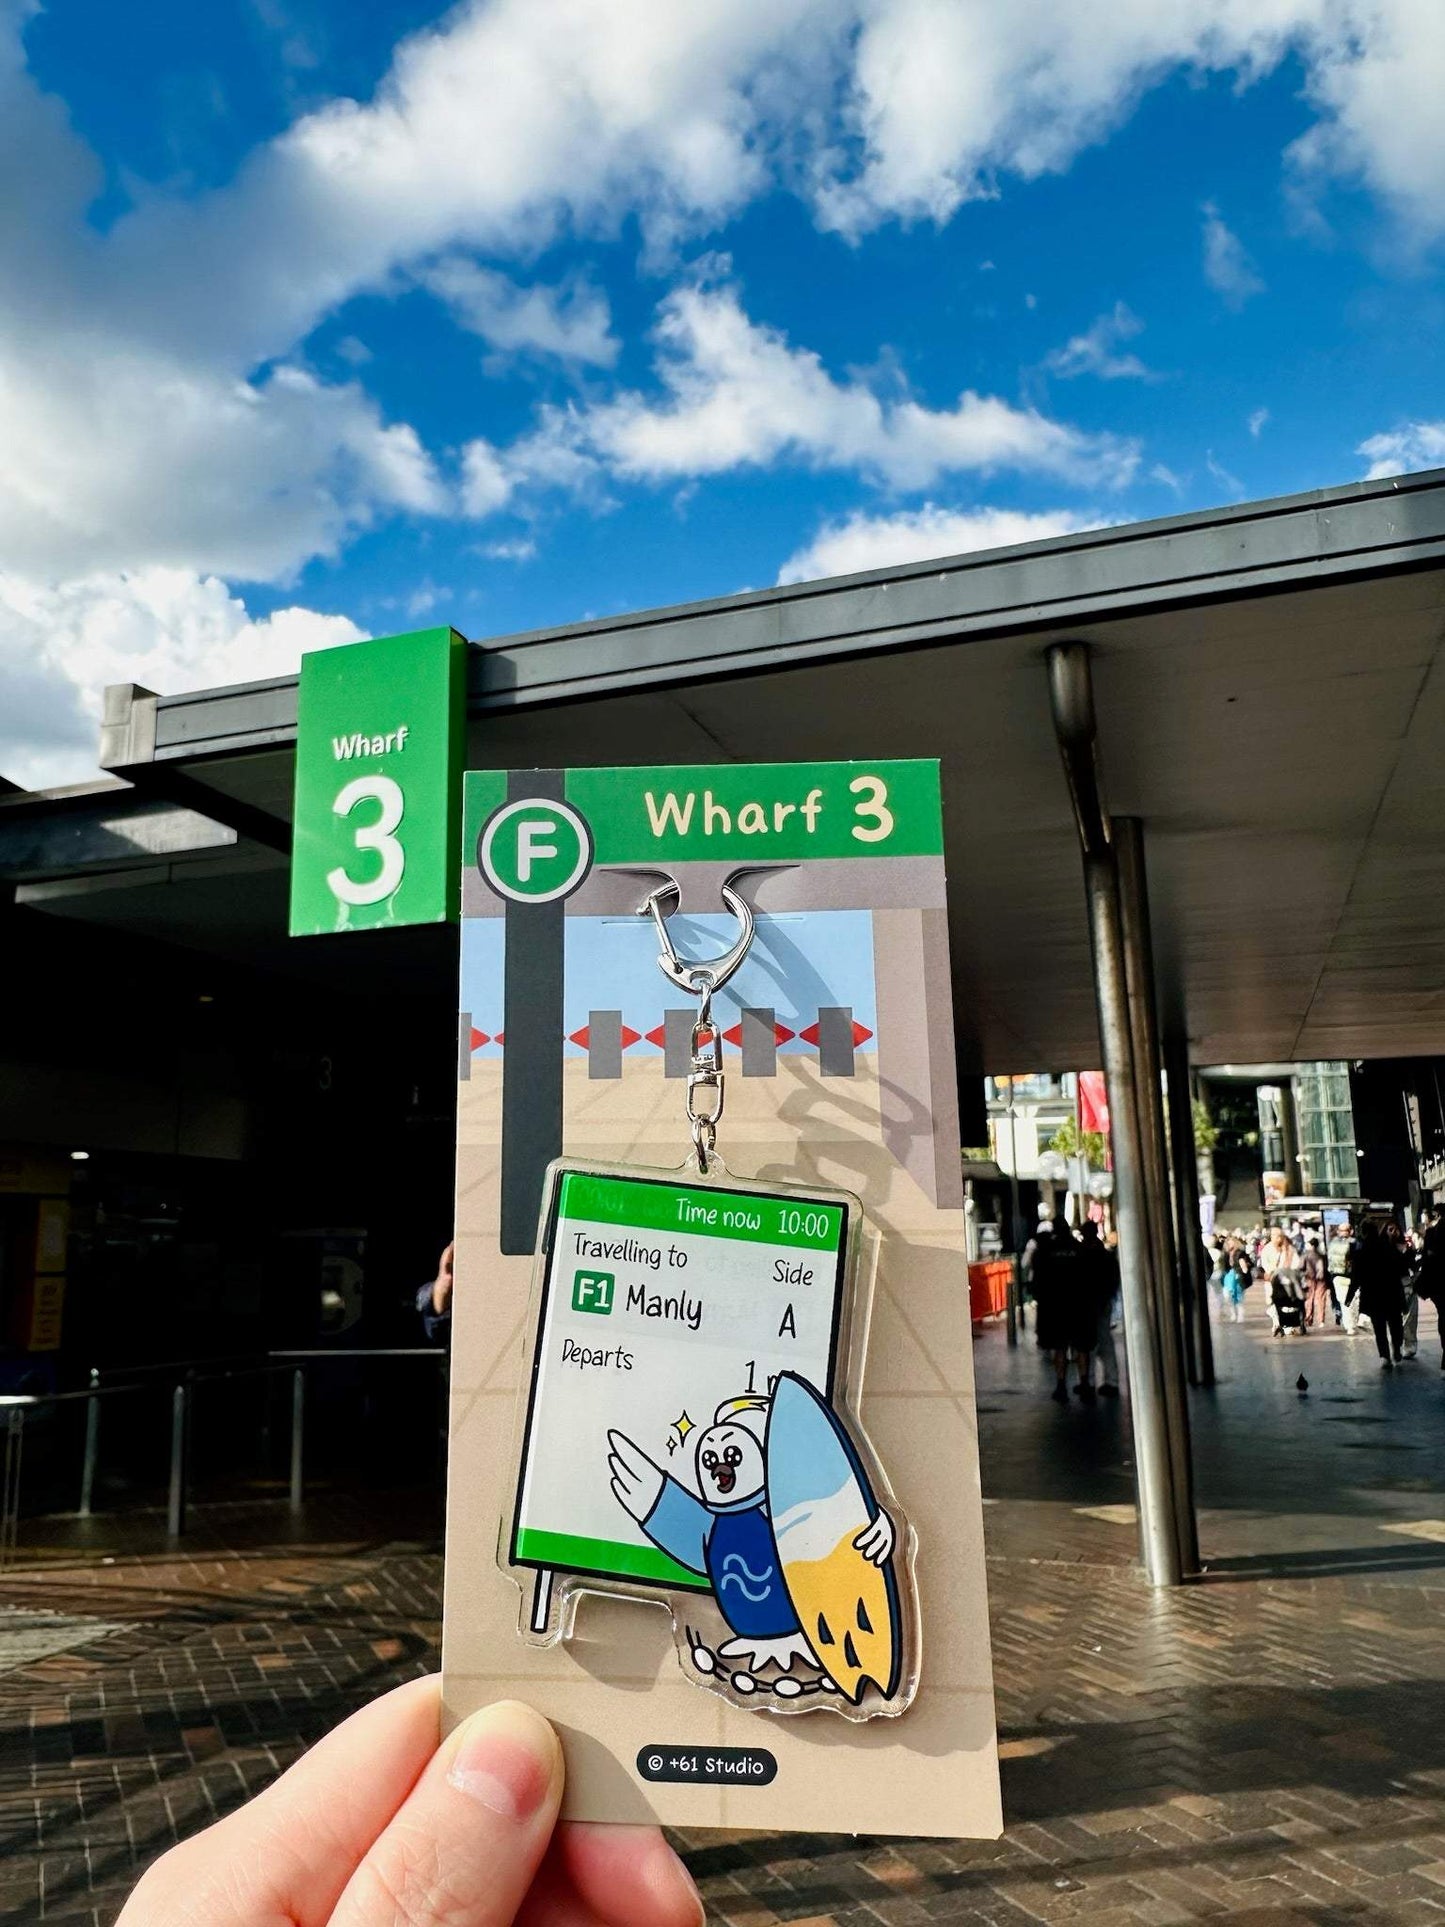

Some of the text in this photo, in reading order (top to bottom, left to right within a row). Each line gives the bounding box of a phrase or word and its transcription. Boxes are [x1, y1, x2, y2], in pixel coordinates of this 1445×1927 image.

[332, 726, 408, 760] Wharf
[644, 775, 894, 842] Wharf 3
[327, 775, 405, 905] 3
[517, 821, 558, 882] F
[676, 1198, 829, 1239] Time now 10:00
[573, 1232, 688, 1269] Travelling to
[772, 1259, 814, 1286] Side
[577, 1278, 703, 1330] F1 Manly
[778, 1303, 797, 1339] A
[562, 1338, 634, 1370] Departs
[744, 1360, 757, 1393] 1
[669, 1756, 698, 1772] +61
[705, 1756, 764, 1775] Studio
